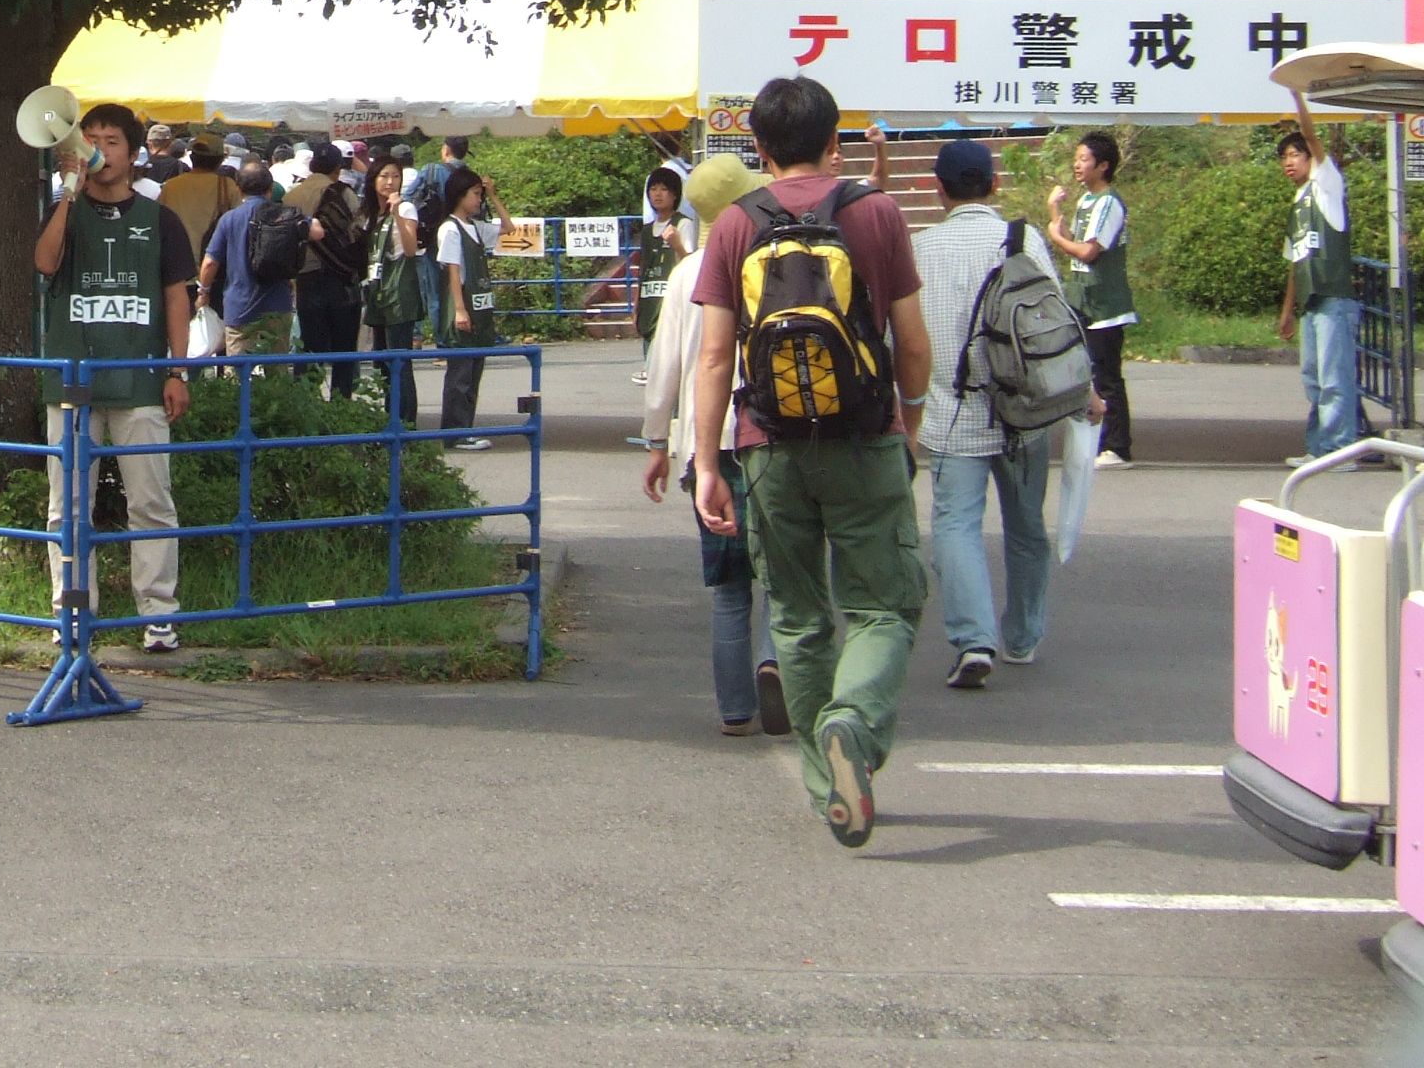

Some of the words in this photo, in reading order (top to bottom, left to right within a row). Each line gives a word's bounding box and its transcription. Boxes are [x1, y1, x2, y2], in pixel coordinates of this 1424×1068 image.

[789, 12, 1309, 70] テロ警戒中
[955, 81, 1138, 104] 掛川警察署
[568, 222, 615, 234] 関係者以外
[574, 236, 610, 248] 立入禁止
[72, 298, 147, 320] STAFF
